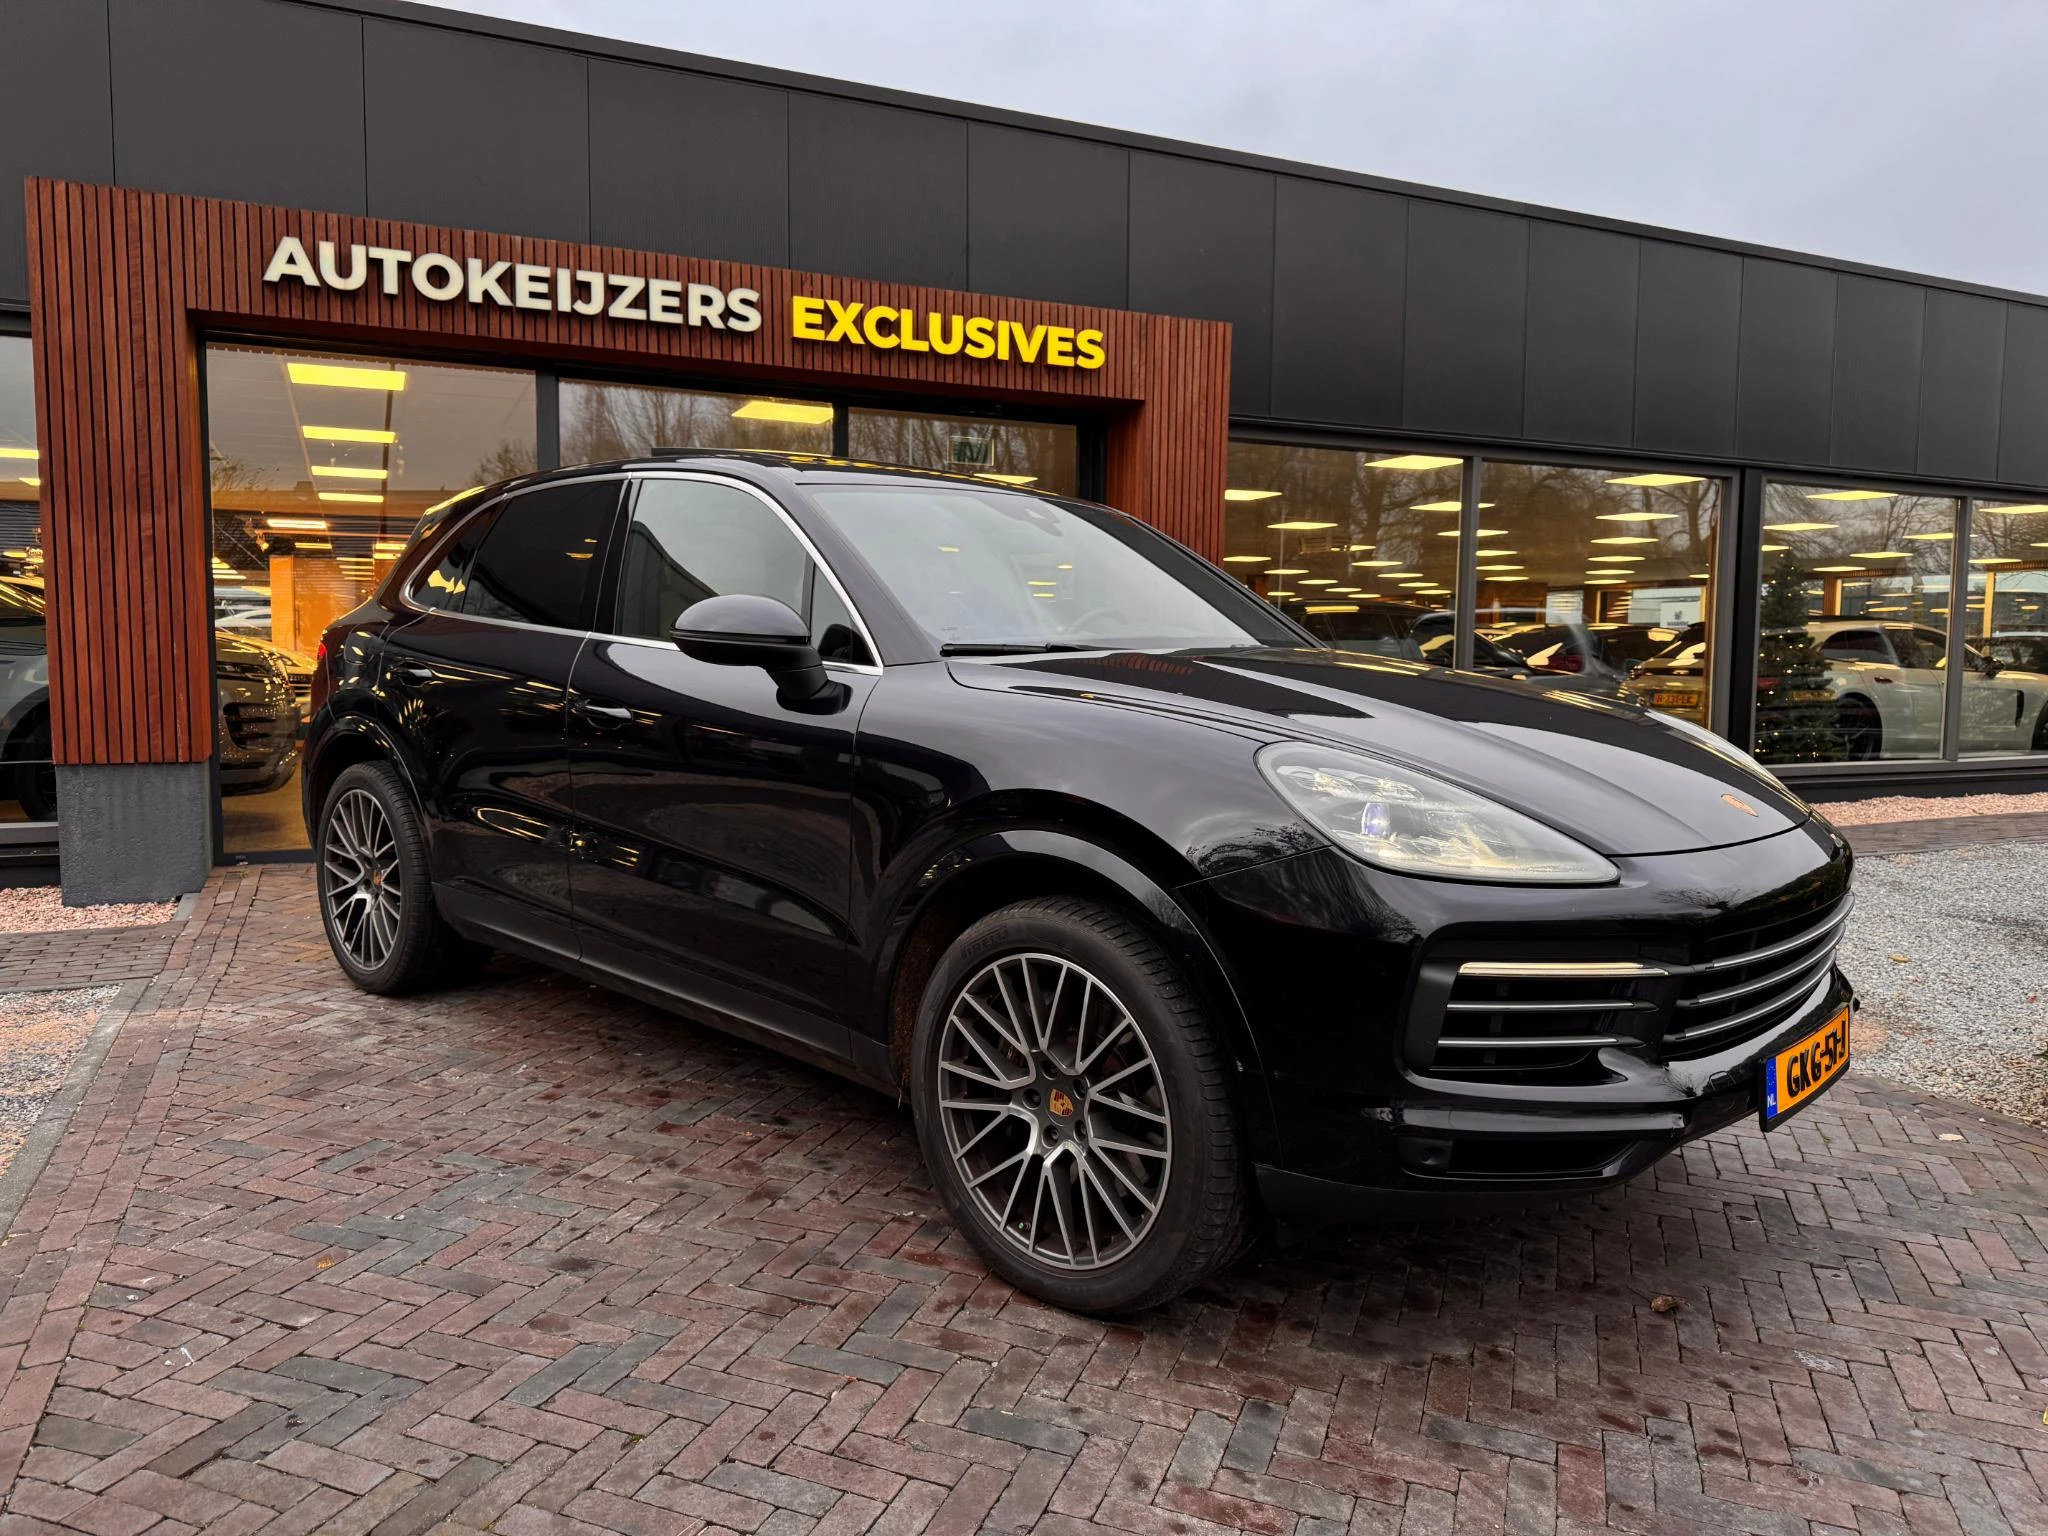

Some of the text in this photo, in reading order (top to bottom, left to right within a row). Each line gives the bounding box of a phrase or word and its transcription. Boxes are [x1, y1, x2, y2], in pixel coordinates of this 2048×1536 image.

[262, 236, 1106, 370] AUTOKEIJZERS EXCLUSIVES
[1767, 1093, 1777, 1108] NL
